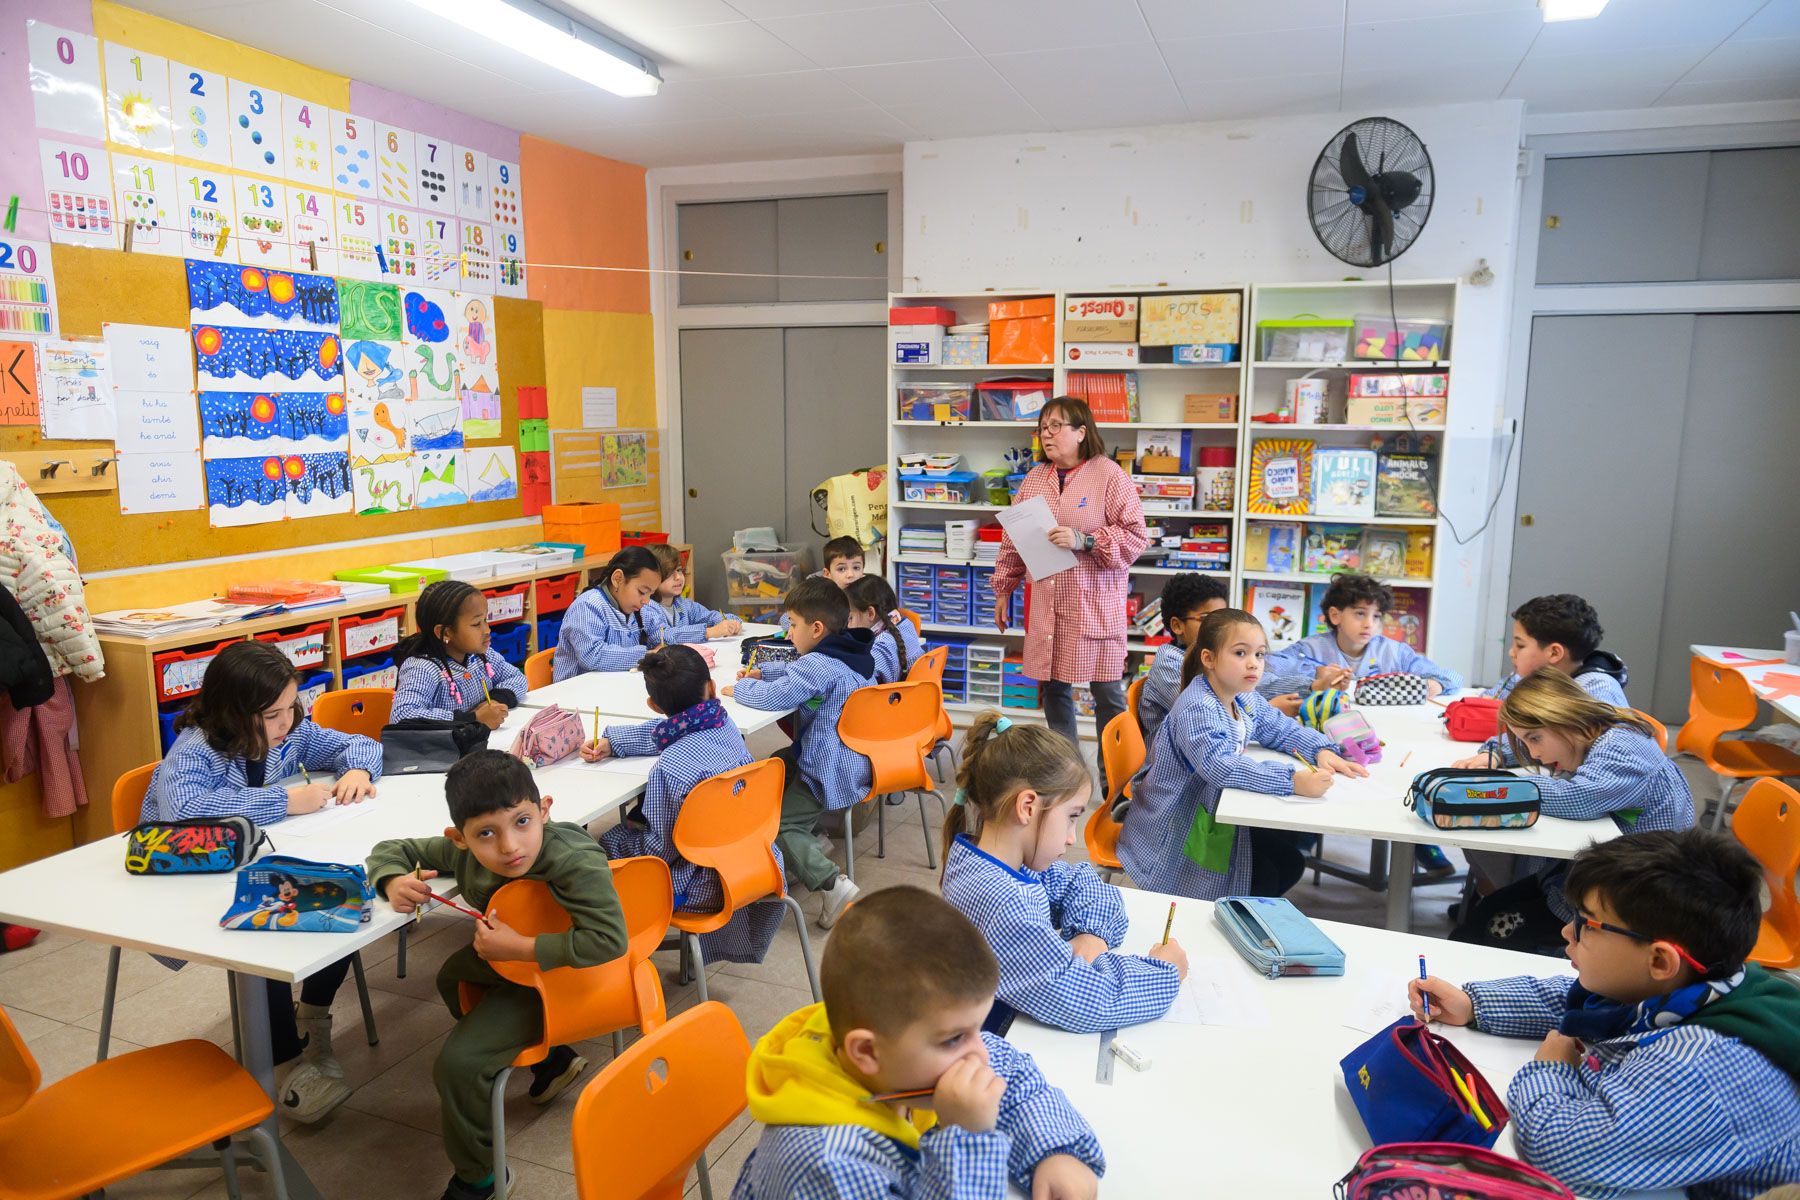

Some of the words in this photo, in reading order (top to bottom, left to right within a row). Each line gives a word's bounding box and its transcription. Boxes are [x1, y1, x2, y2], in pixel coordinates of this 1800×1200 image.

[57, 37, 75, 64] 0
[130, 56, 142, 81] 1
[189, 72, 205, 97] 2
[249, 90, 264, 115] 3
[298, 105, 312, 128] 4
[345, 119, 357, 140] 5
[387, 132, 398, 153] 6
[427, 143, 438, 163] 7
[55, 151, 89, 181] 10
[465, 152, 475, 172] 8
[130, 165, 155, 191] 11
[500, 165, 510, 185] 9
[189, 177, 218, 203] 12
[248, 183, 274, 208] 13
[296, 193, 319, 216] 14
[343, 203, 365, 226] 15
[387, 212, 409, 235] 16
[426, 219, 446, 240] 17
[465, 225, 484, 246] 18
[501, 233, 517, 253] 19
[0, 242, 37, 274] 20
[1080, 299, 1126, 318] Quest
[1168, 303, 1212, 317] POTS
